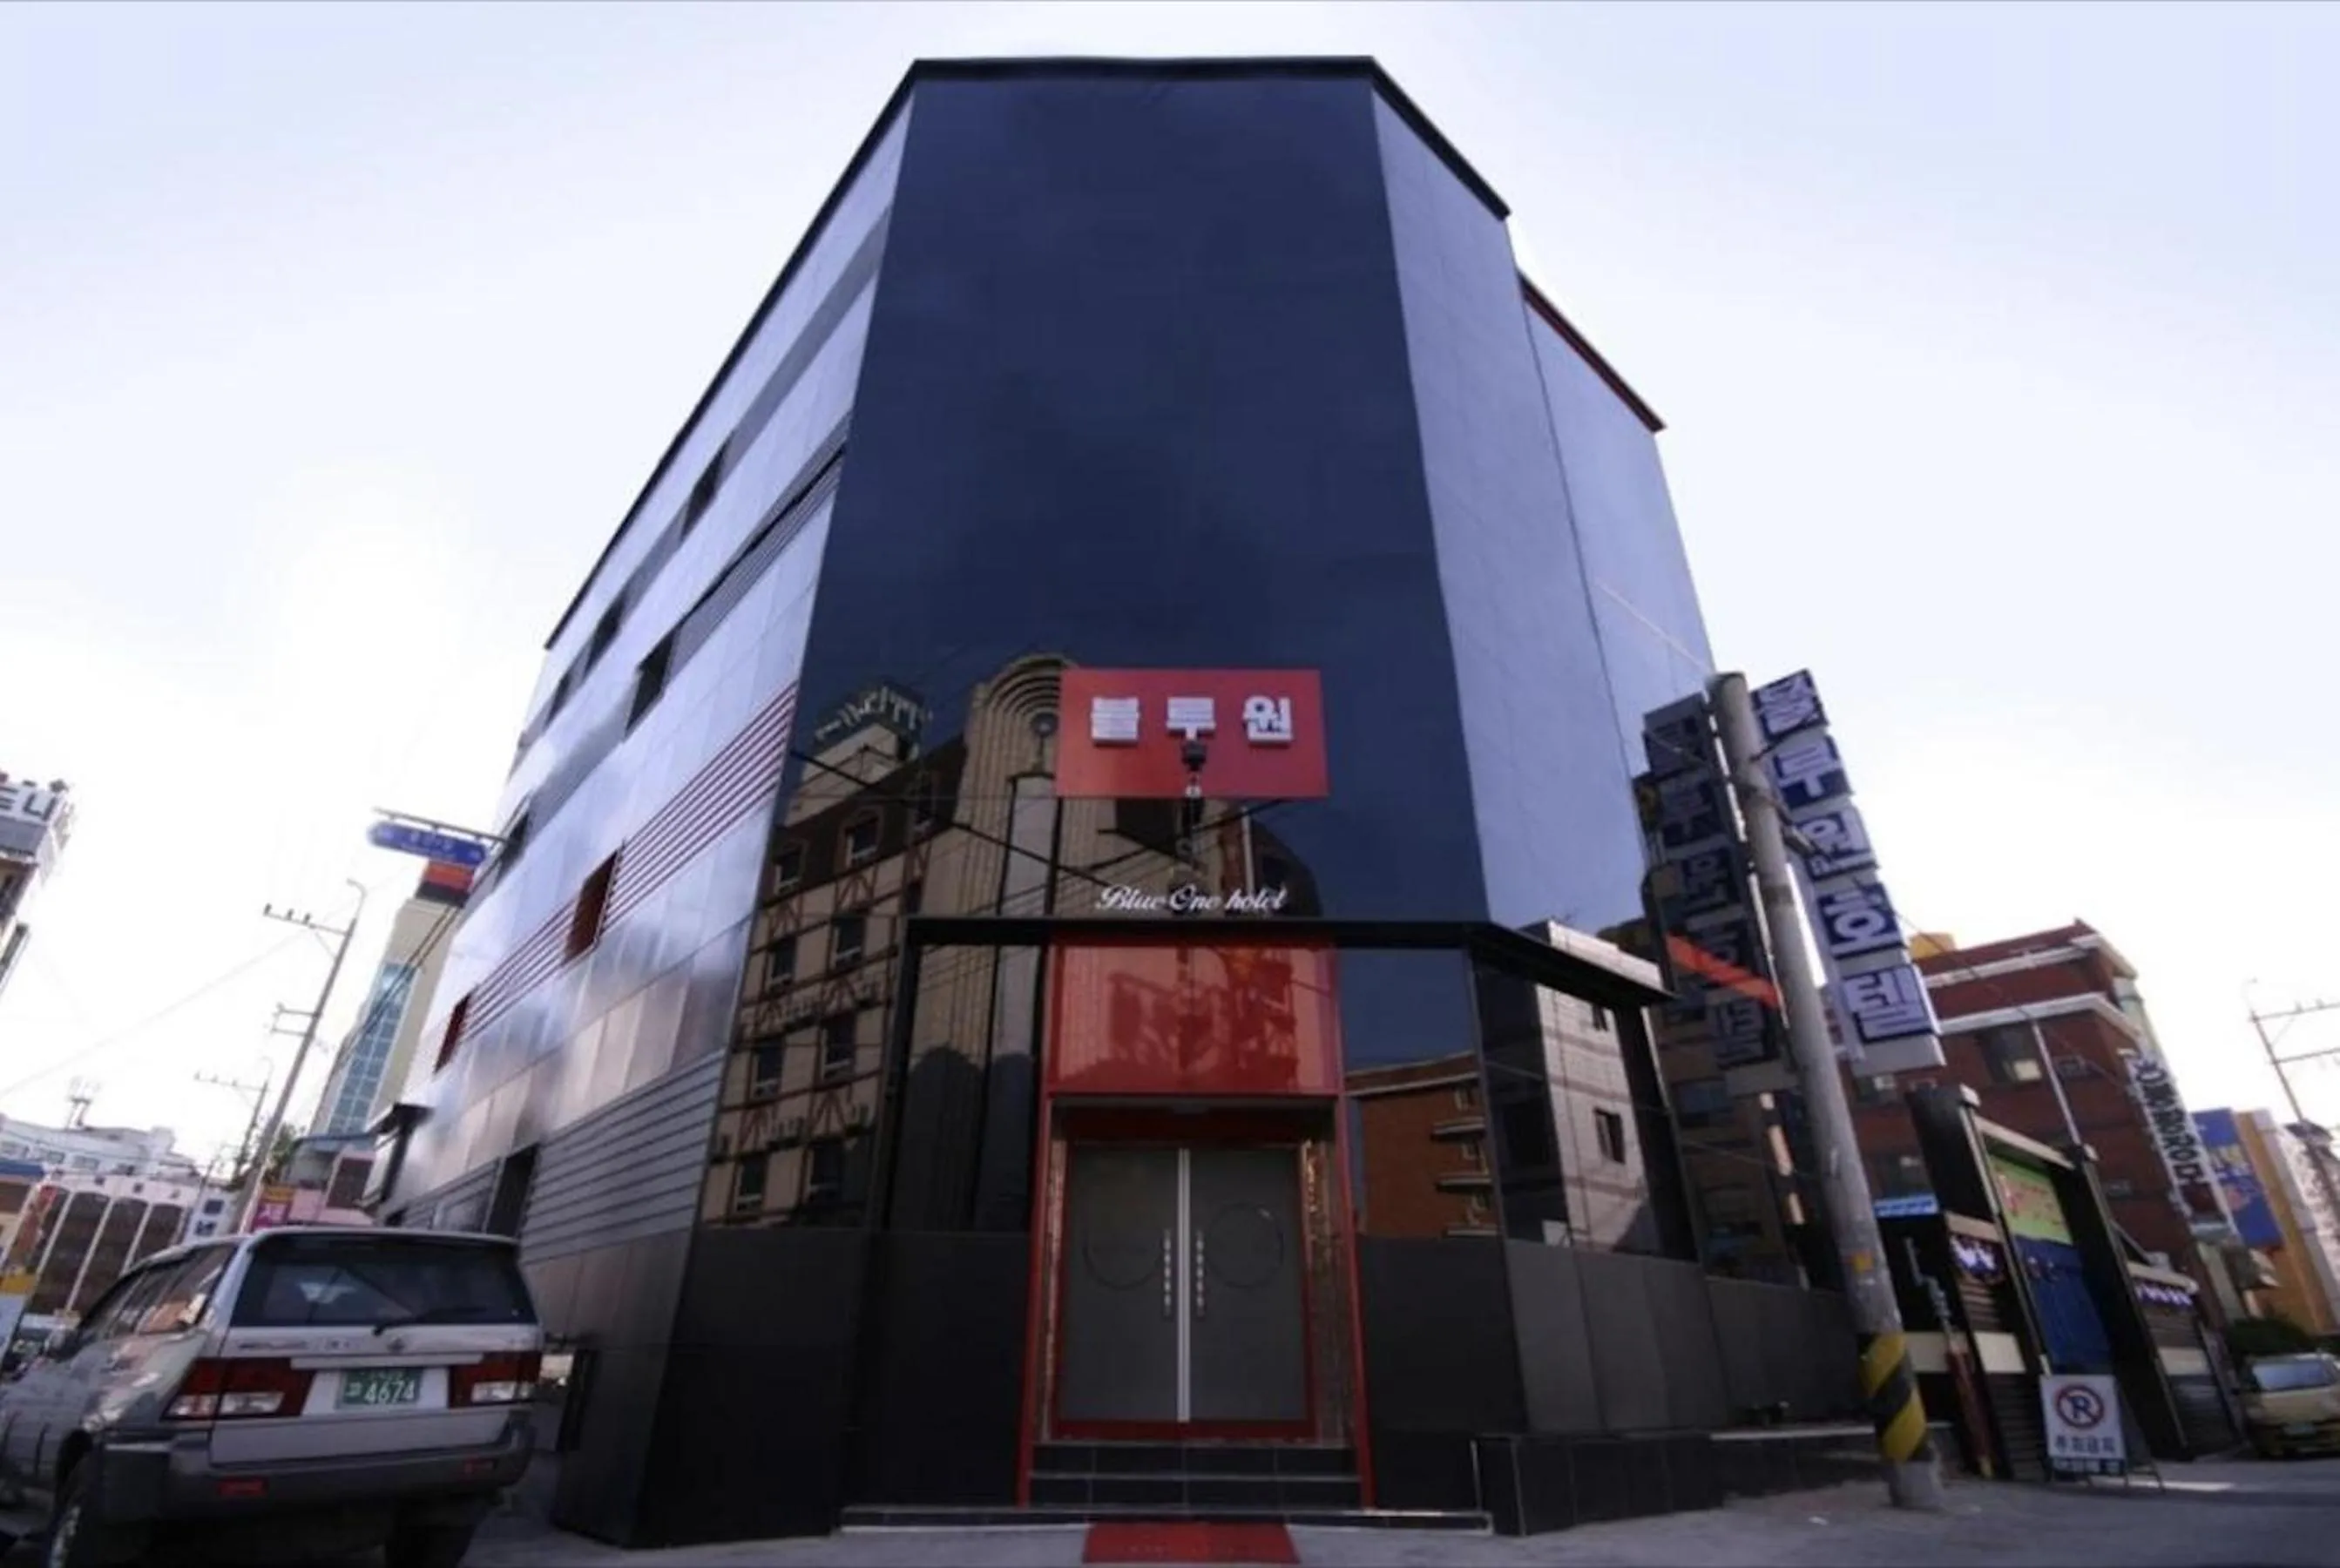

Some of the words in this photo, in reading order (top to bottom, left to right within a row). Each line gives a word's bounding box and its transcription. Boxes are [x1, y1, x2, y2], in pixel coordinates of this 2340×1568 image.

[1091, 695, 1293, 743] 블루원
[1094, 883, 1167, 910] Blue
[1168, 883, 1221, 911] One
[1223, 881, 1288, 910] hotel
